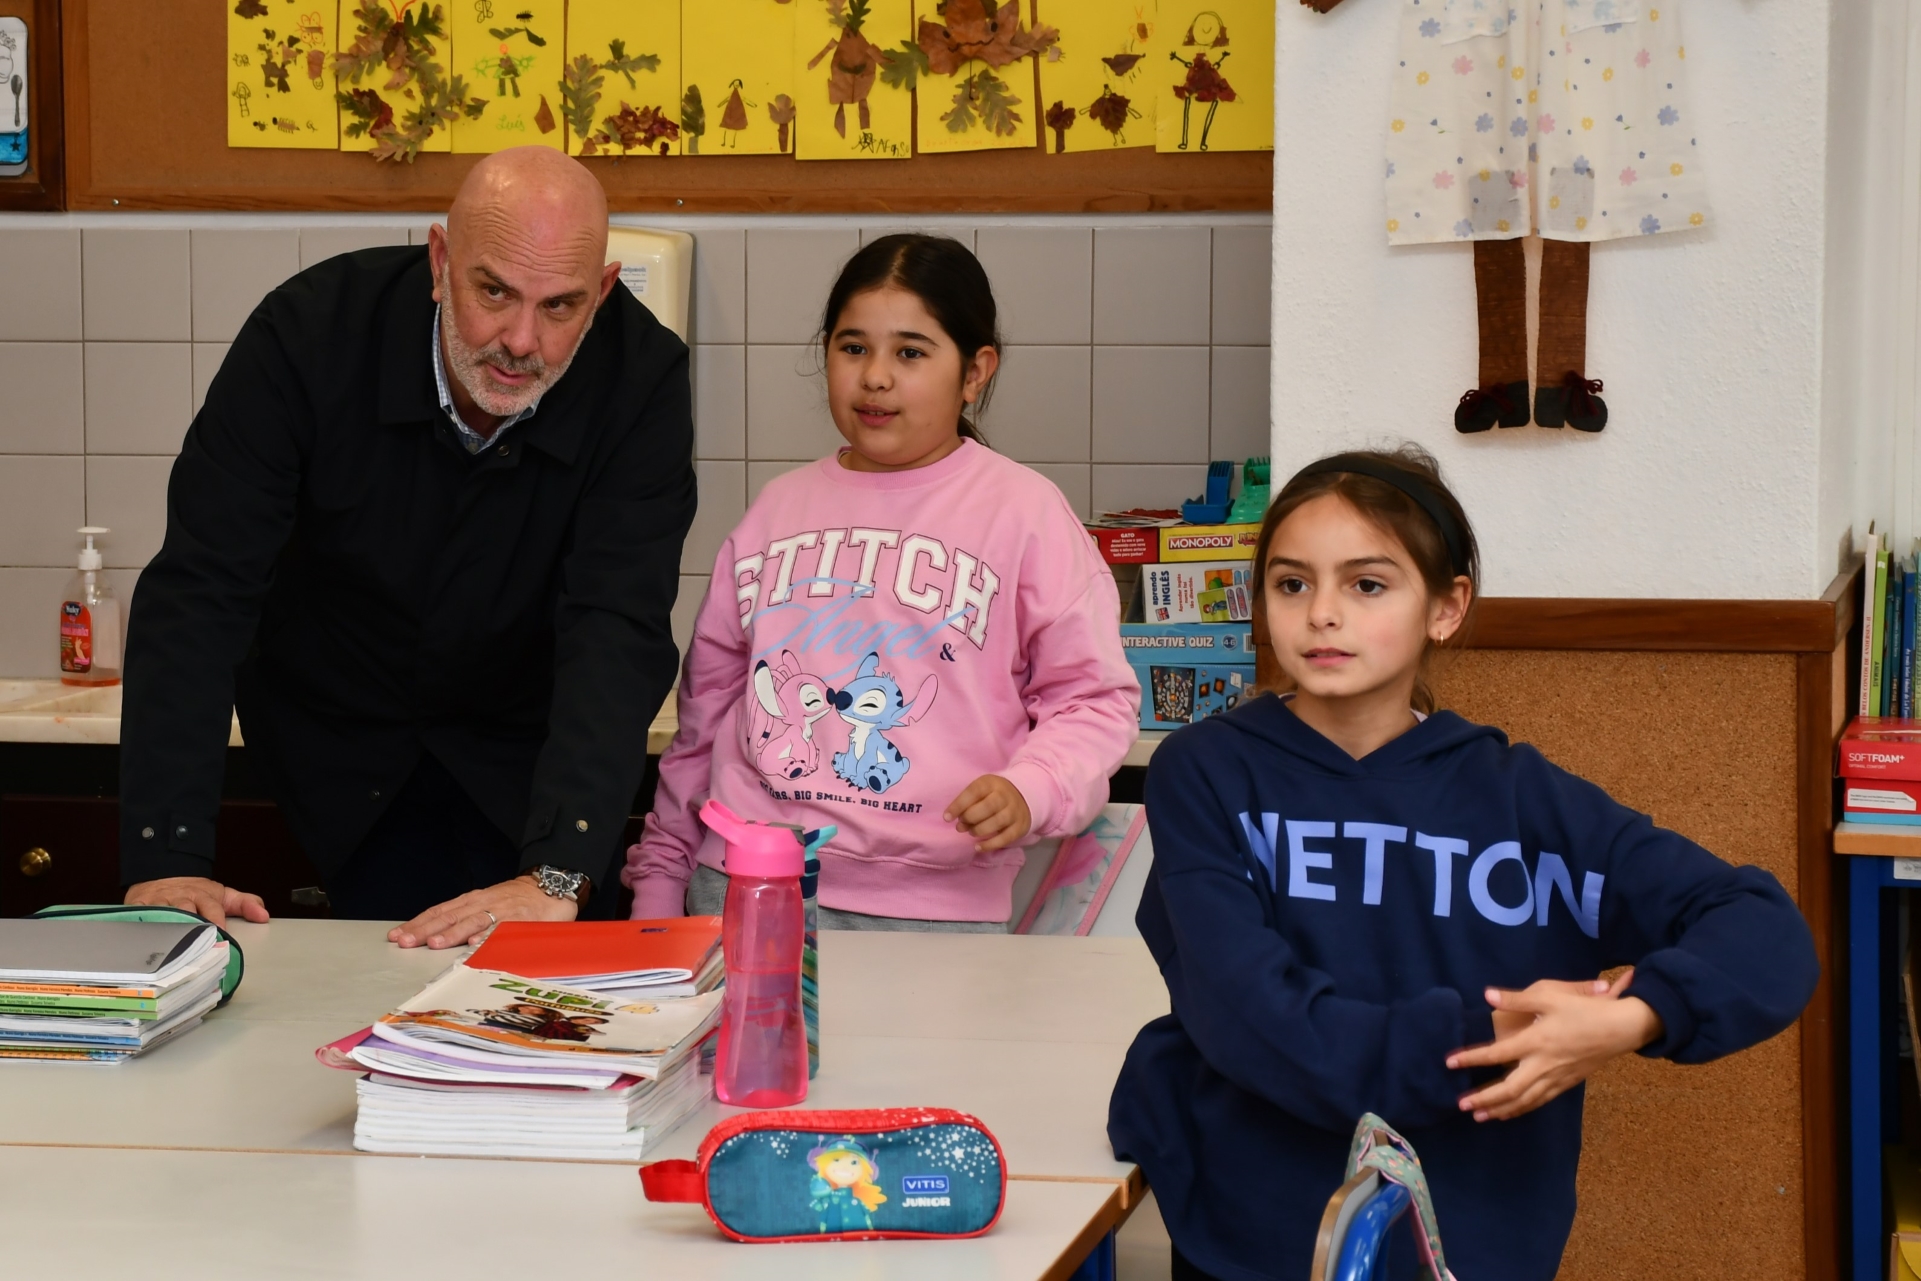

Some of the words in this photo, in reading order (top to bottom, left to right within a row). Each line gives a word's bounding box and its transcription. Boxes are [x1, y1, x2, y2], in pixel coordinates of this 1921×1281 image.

[1170, 537, 1232, 548] MONOPOLY
[734, 526, 1000, 651] STITCH
[1150, 572, 1158, 605] aprendo
[1159, 570, 1171, 605] INGLÊS
[1188, 636, 1214, 648] QUIZ
[940, 643, 956, 662] &
[1864, 658, 1869, 666] DE
[794, 790, 812, 800] BIG
[861, 798, 879, 808] BIG
[884, 801, 922, 813] HEART
[906, 1180, 945, 1189] VITIS
[902, 1196, 951, 1207] JUNIOR
